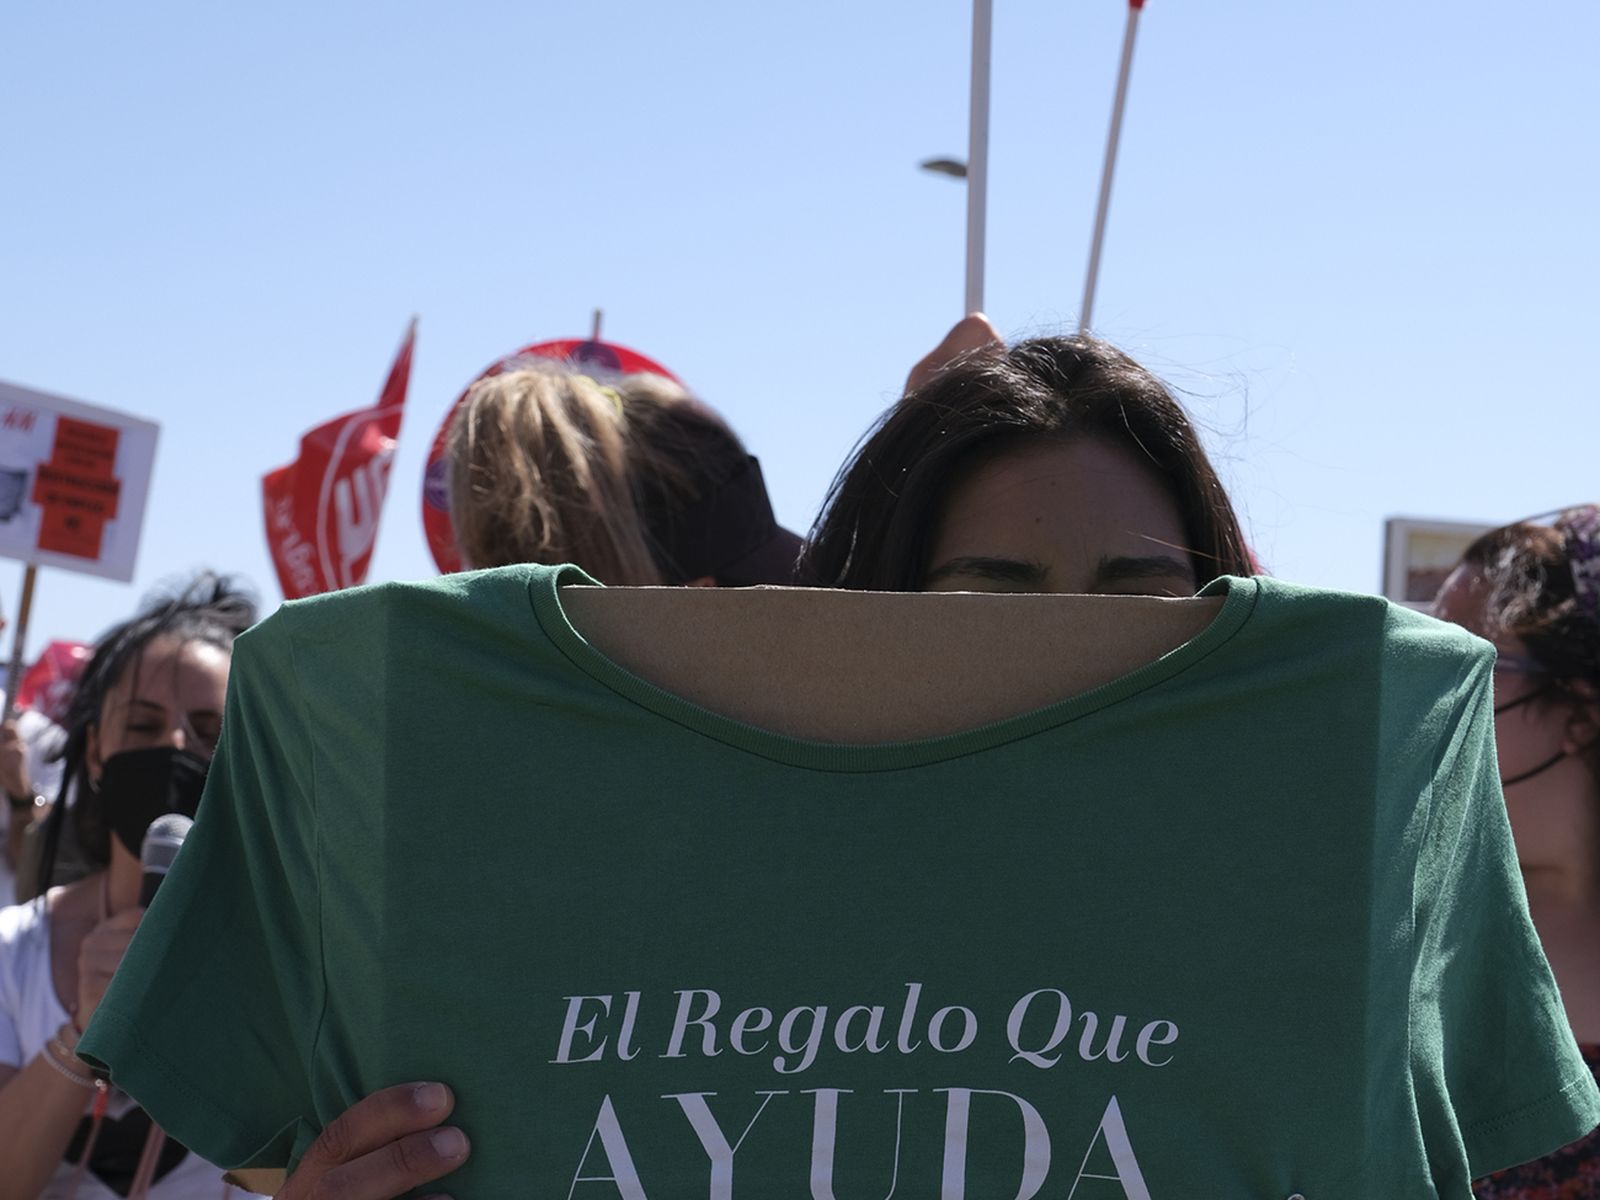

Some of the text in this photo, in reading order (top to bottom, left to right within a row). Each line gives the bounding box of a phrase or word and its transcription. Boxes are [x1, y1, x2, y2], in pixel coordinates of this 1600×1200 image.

[548, 983, 1179, 1073] El Regalo Que
